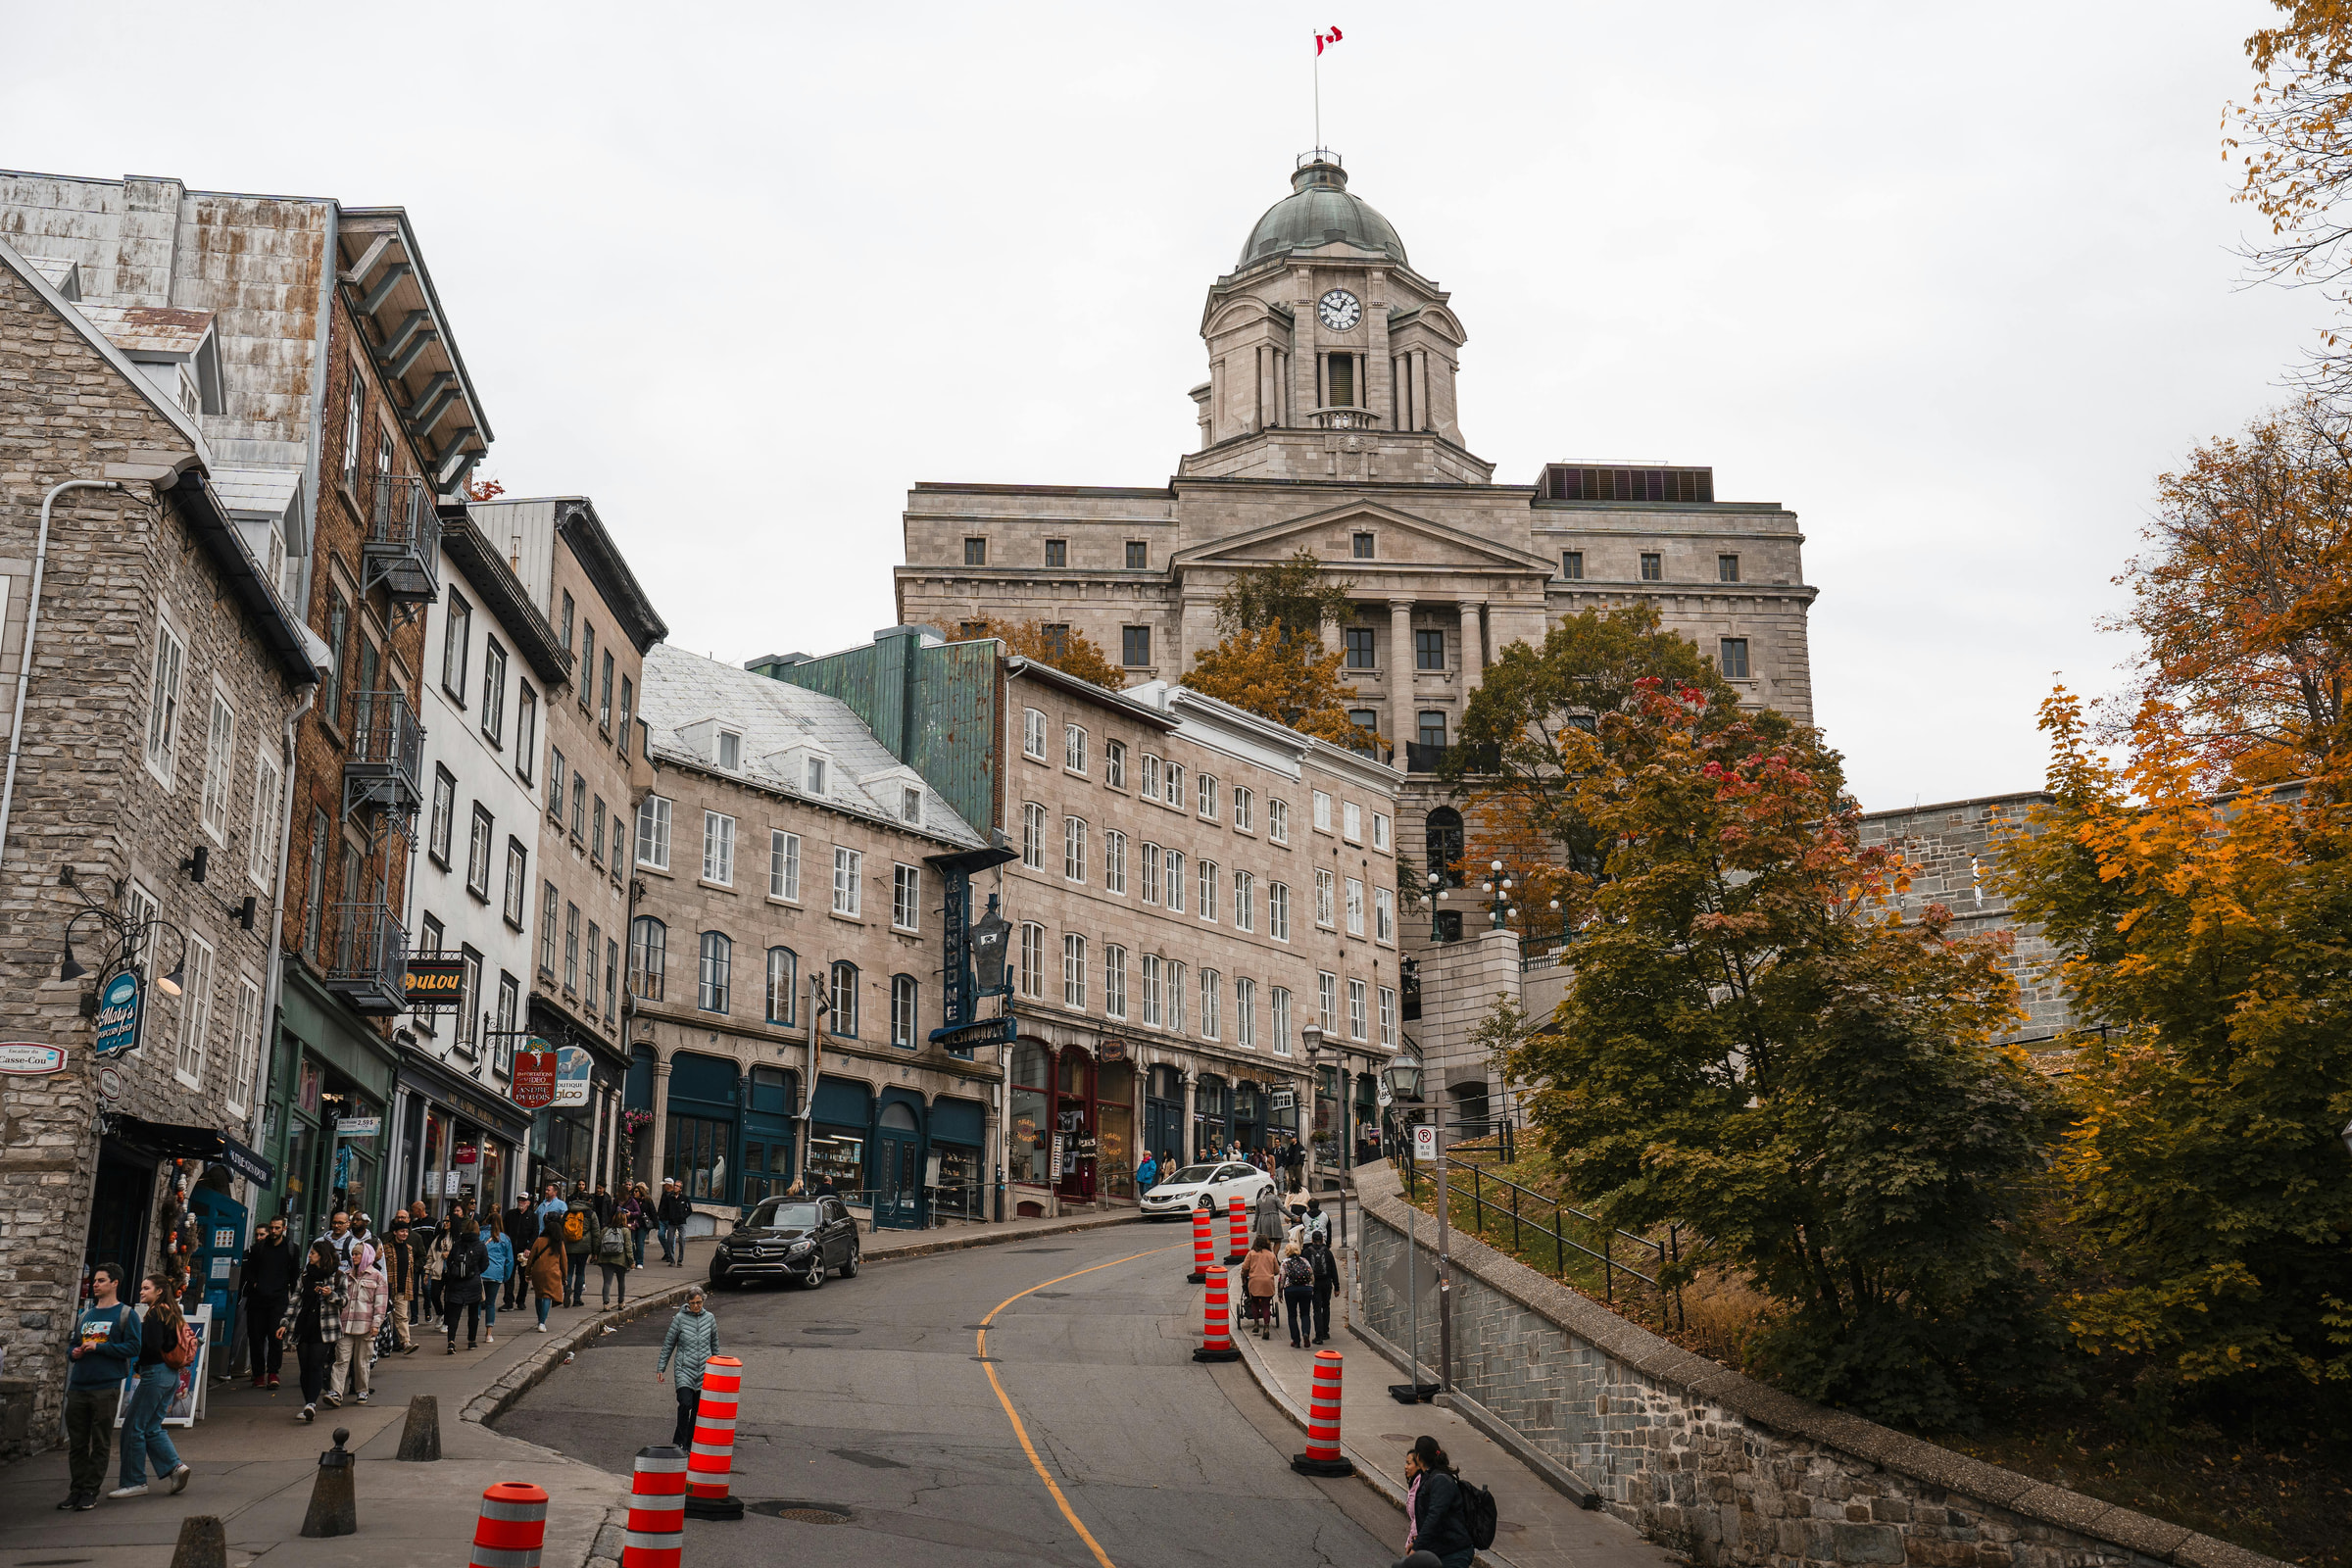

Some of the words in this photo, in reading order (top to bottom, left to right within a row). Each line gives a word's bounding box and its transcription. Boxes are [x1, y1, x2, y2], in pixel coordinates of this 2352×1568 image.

[98, 1004, 135, 1036] Mary's
[0, 1055, 47, 1064] Casse-Cou
[555, 1089, 583, 1102] gloo
